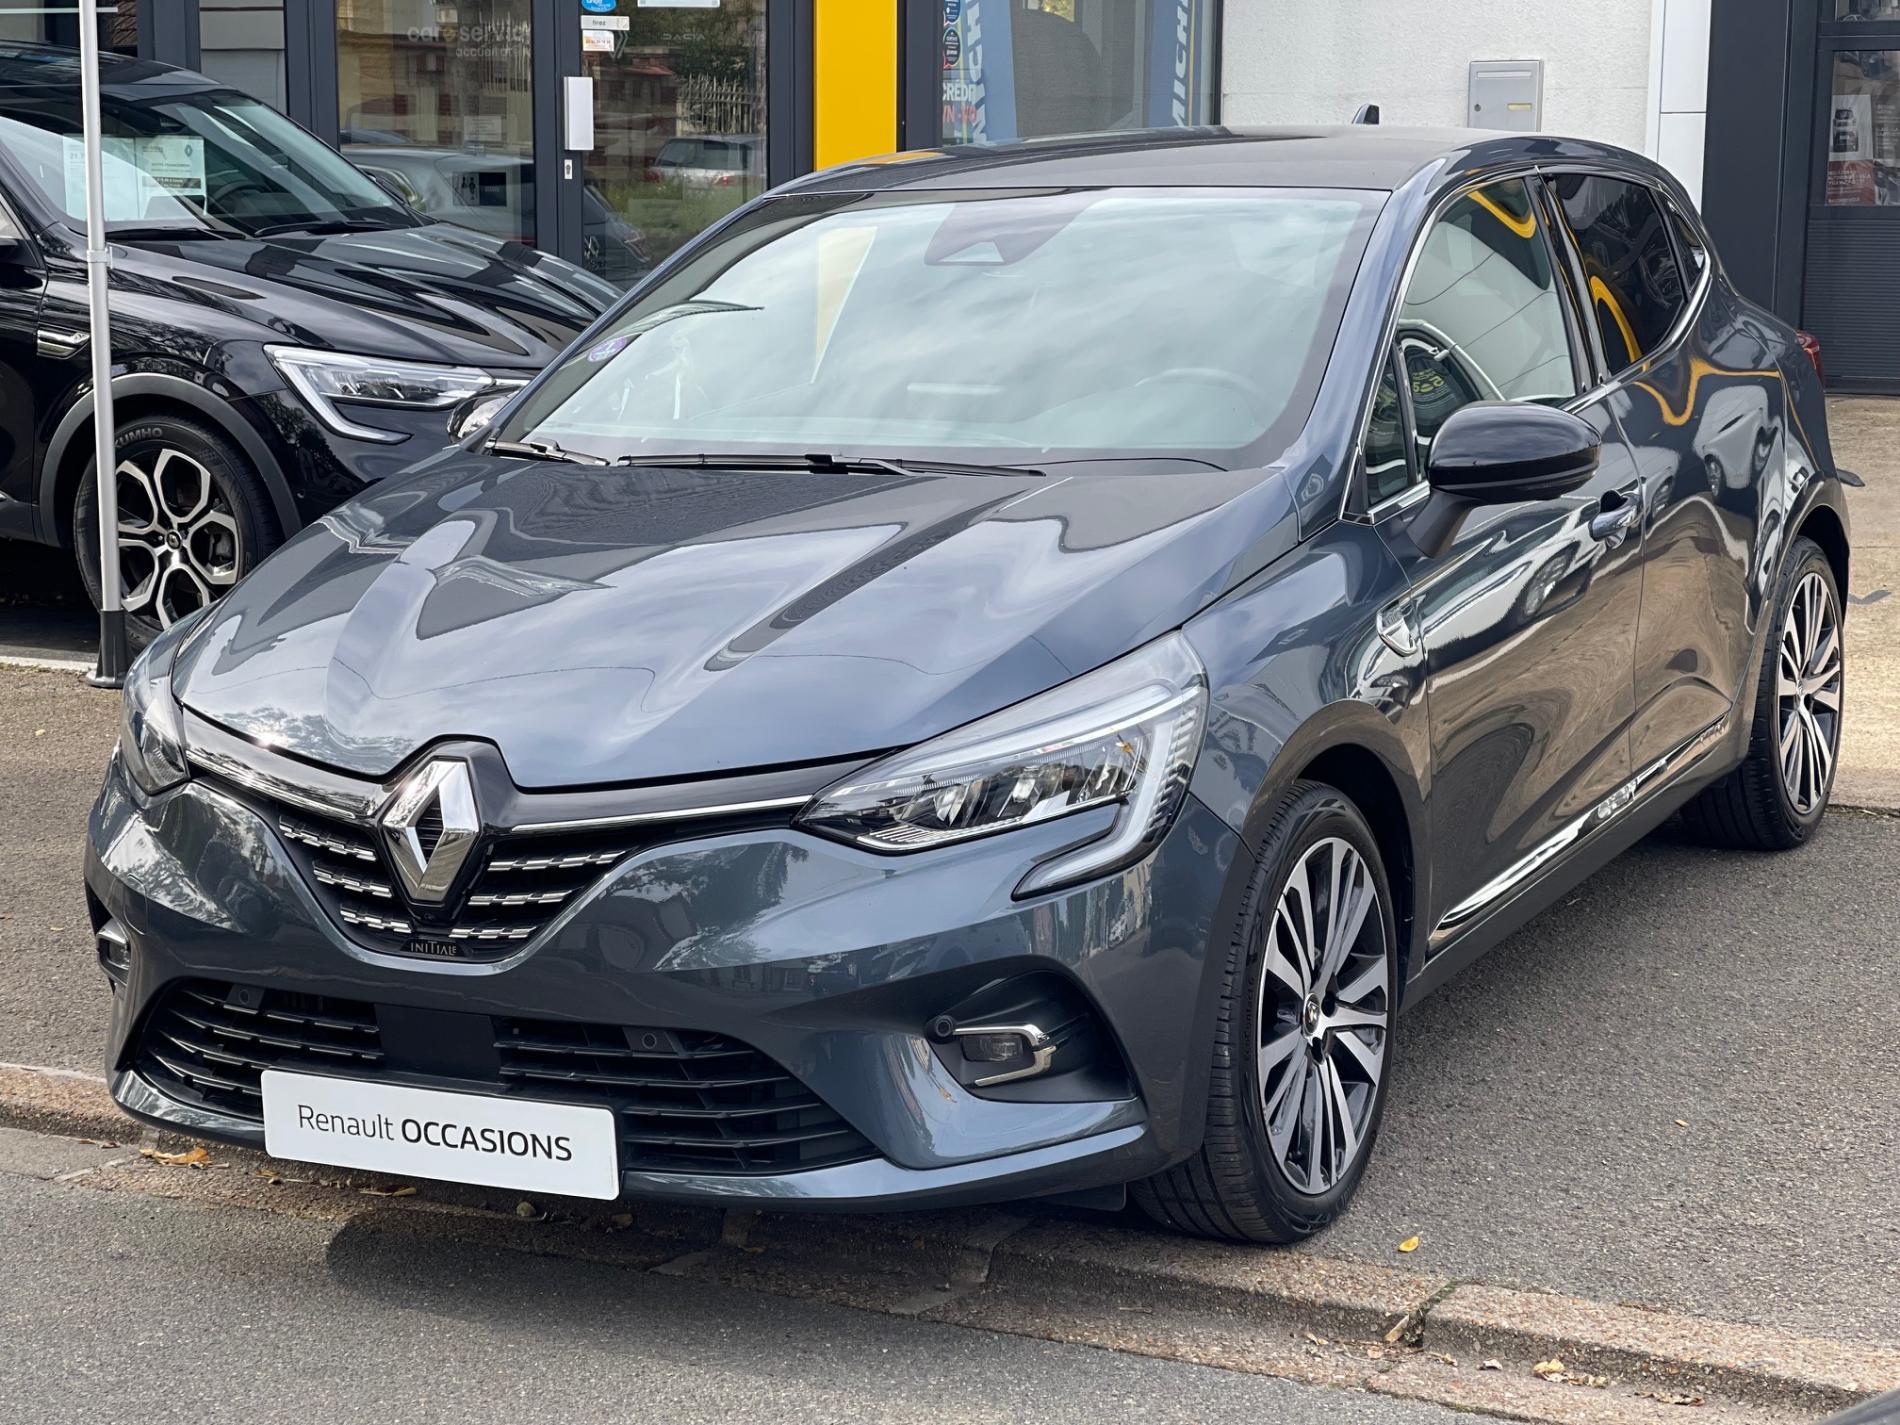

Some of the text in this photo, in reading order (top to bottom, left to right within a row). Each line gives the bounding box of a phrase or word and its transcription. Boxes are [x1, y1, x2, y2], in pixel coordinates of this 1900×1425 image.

[1172, 0, 1189, 127] MICH
[410, 940, 457, 956] INITIALE
[297, 1104, 573, 1162] Renault OCCASIONS
